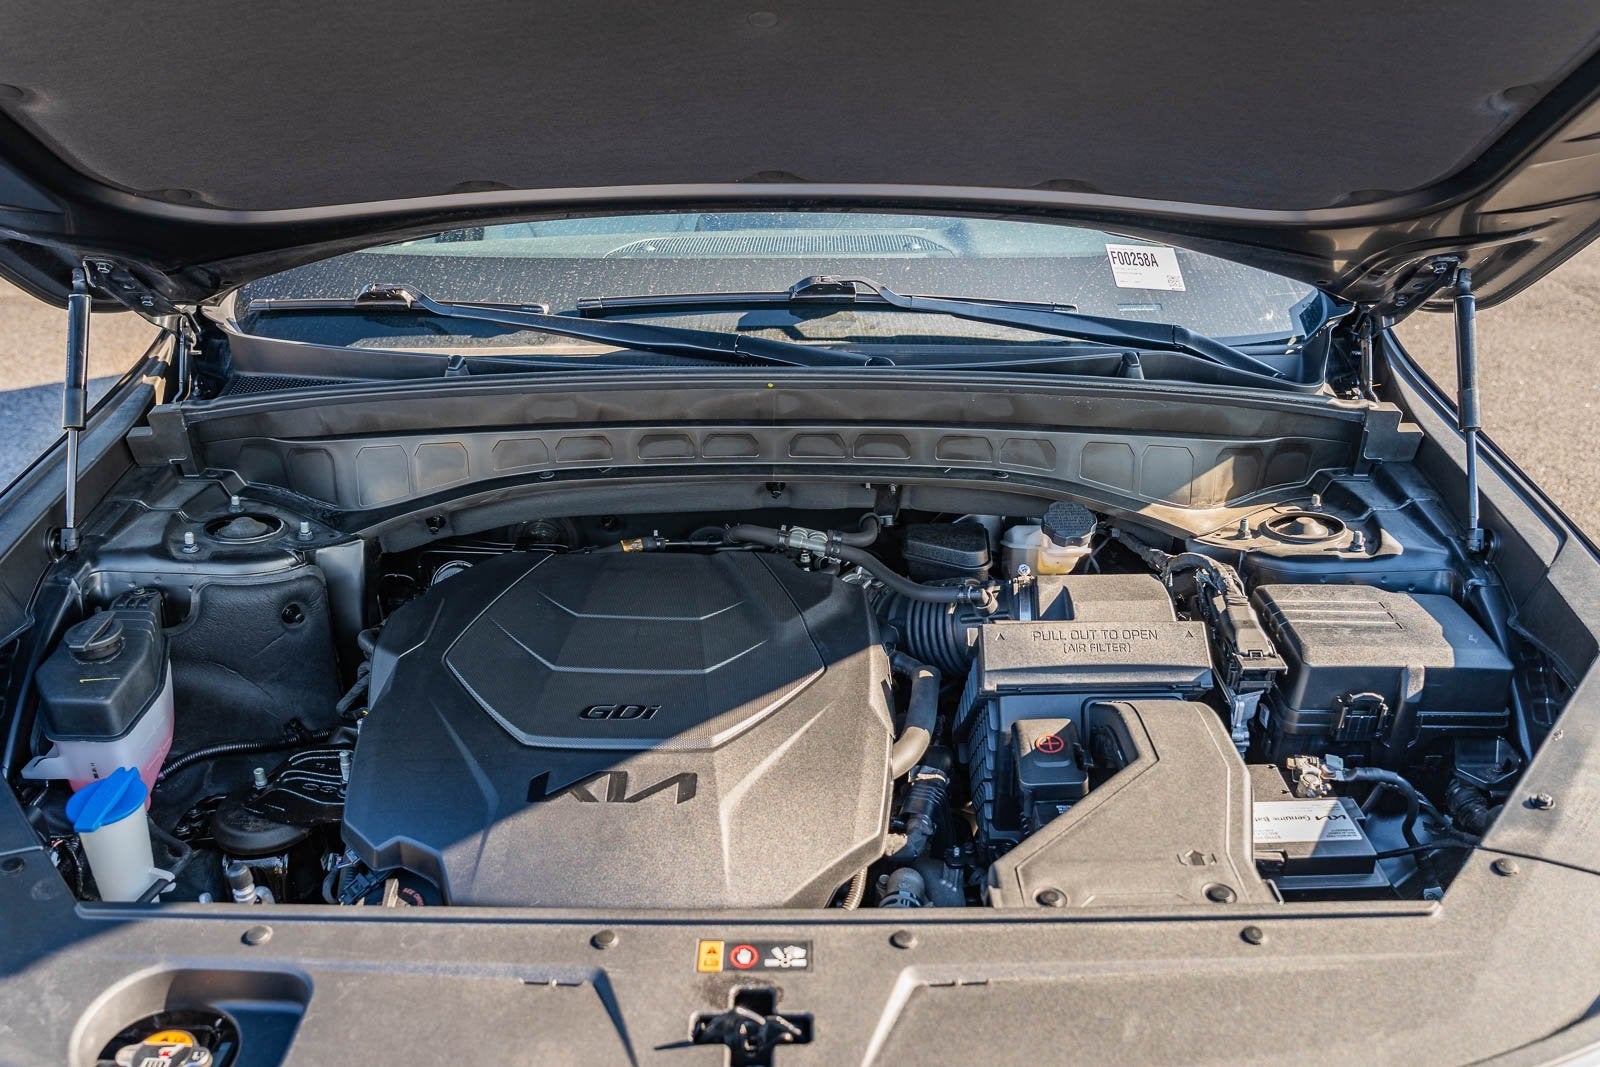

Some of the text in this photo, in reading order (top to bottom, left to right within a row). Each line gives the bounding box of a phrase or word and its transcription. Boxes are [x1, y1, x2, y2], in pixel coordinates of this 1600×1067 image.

[1110, 251, 1159, 268] F00258A
[1032, 630, 1158, 641] PULL OUT TO OPEN
[579, 704, 663, 720] GDi
[526, 770, 698, 804] KIA
